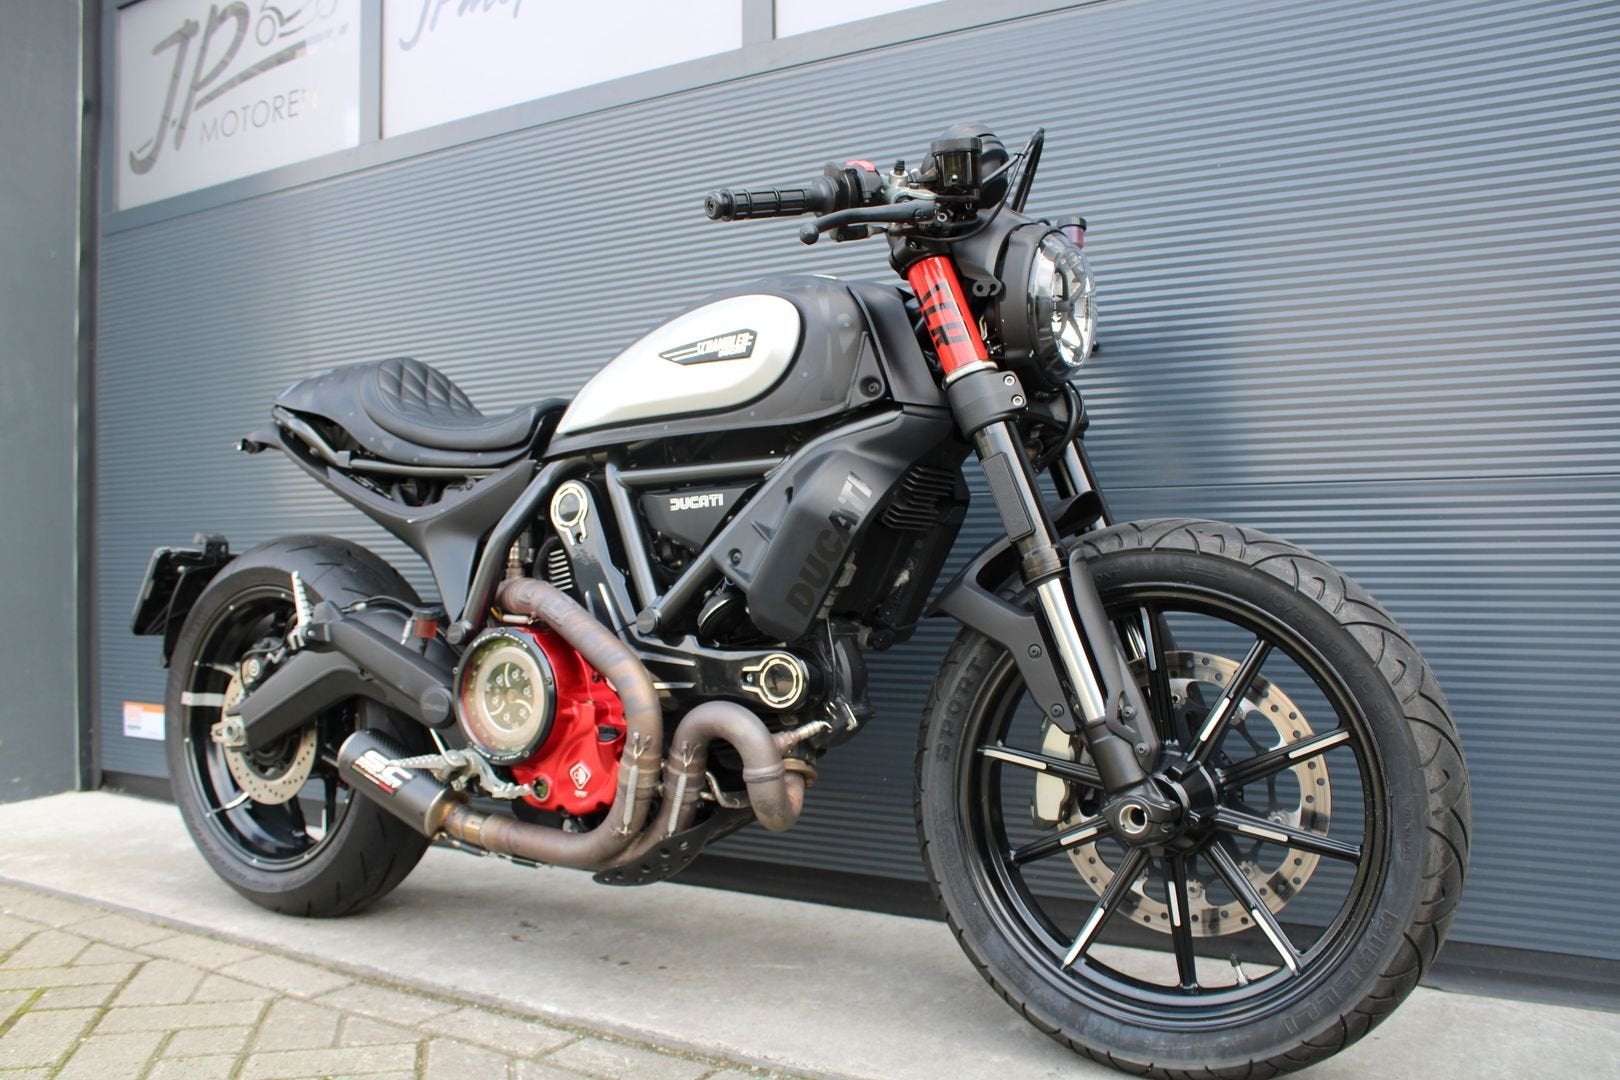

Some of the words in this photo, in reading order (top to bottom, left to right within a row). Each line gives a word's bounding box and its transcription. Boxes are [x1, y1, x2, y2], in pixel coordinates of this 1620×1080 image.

[200, 87, 312, 144] MOTORE
[669, 493, 724, 511] DUCATI
[785, 470, 873, 618] DUCATI
[935, 653, 983, 762] SPORT
[1282, 908, 1399, 1035] PIRELLI
